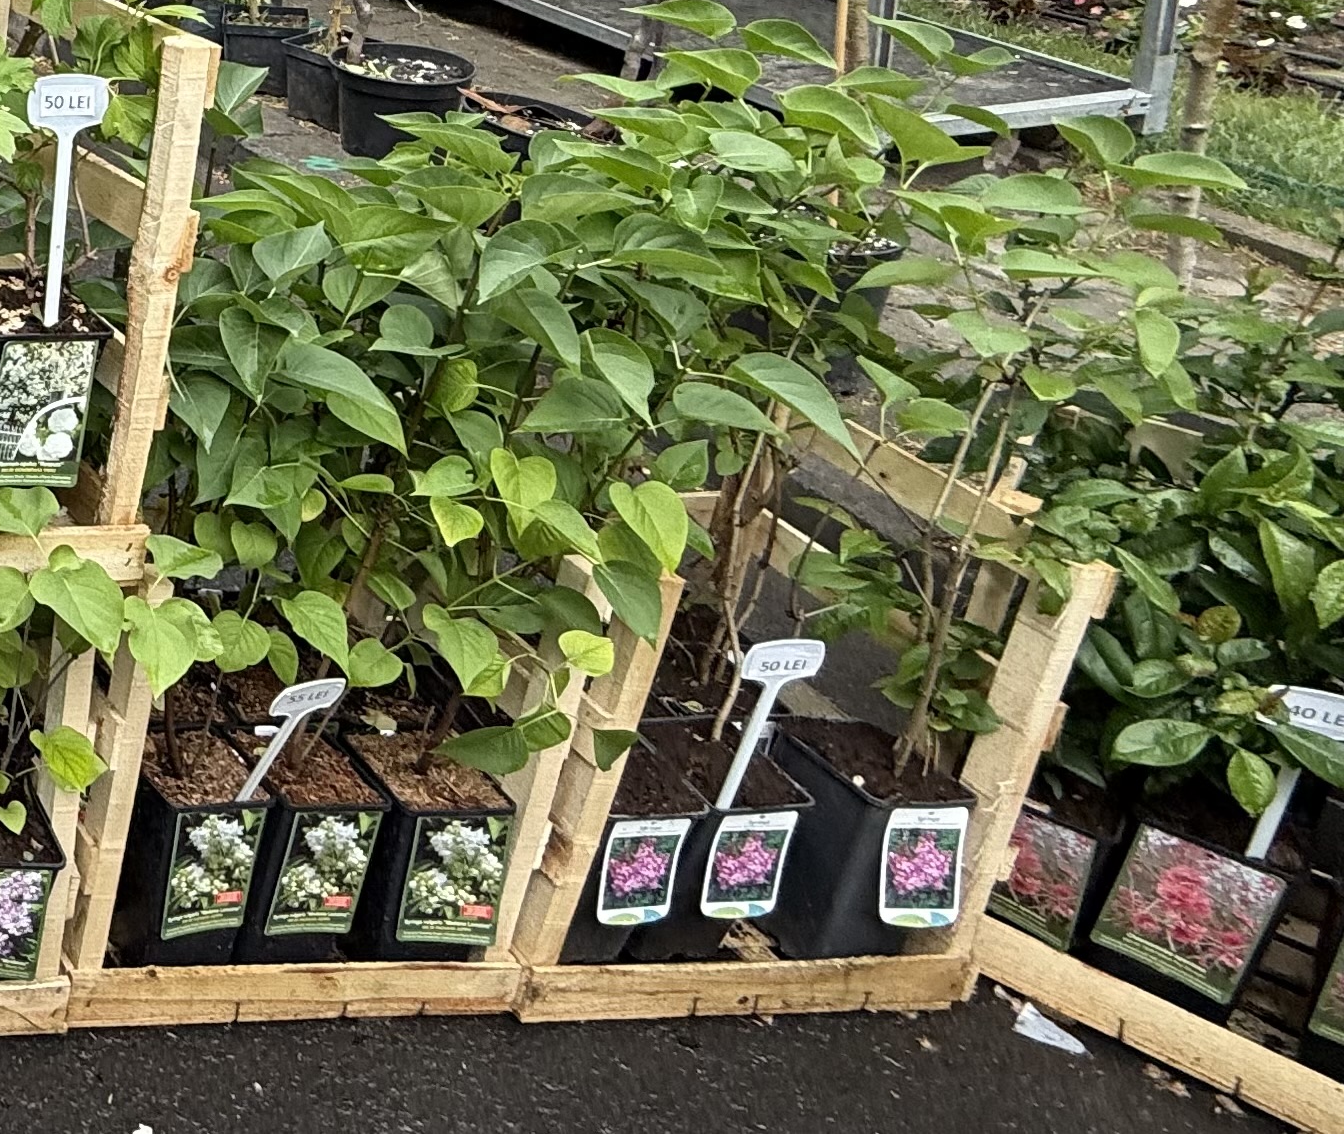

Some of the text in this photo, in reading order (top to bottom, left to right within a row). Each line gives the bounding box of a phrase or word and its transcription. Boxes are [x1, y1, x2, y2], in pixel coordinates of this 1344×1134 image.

[44, 95, 91, 109] 50 LEI
[759, 659, 807, 672] 50 LEI
[307, 689, 329, 700] LEI
[1289, 705, 1344, 727] 40 LE
